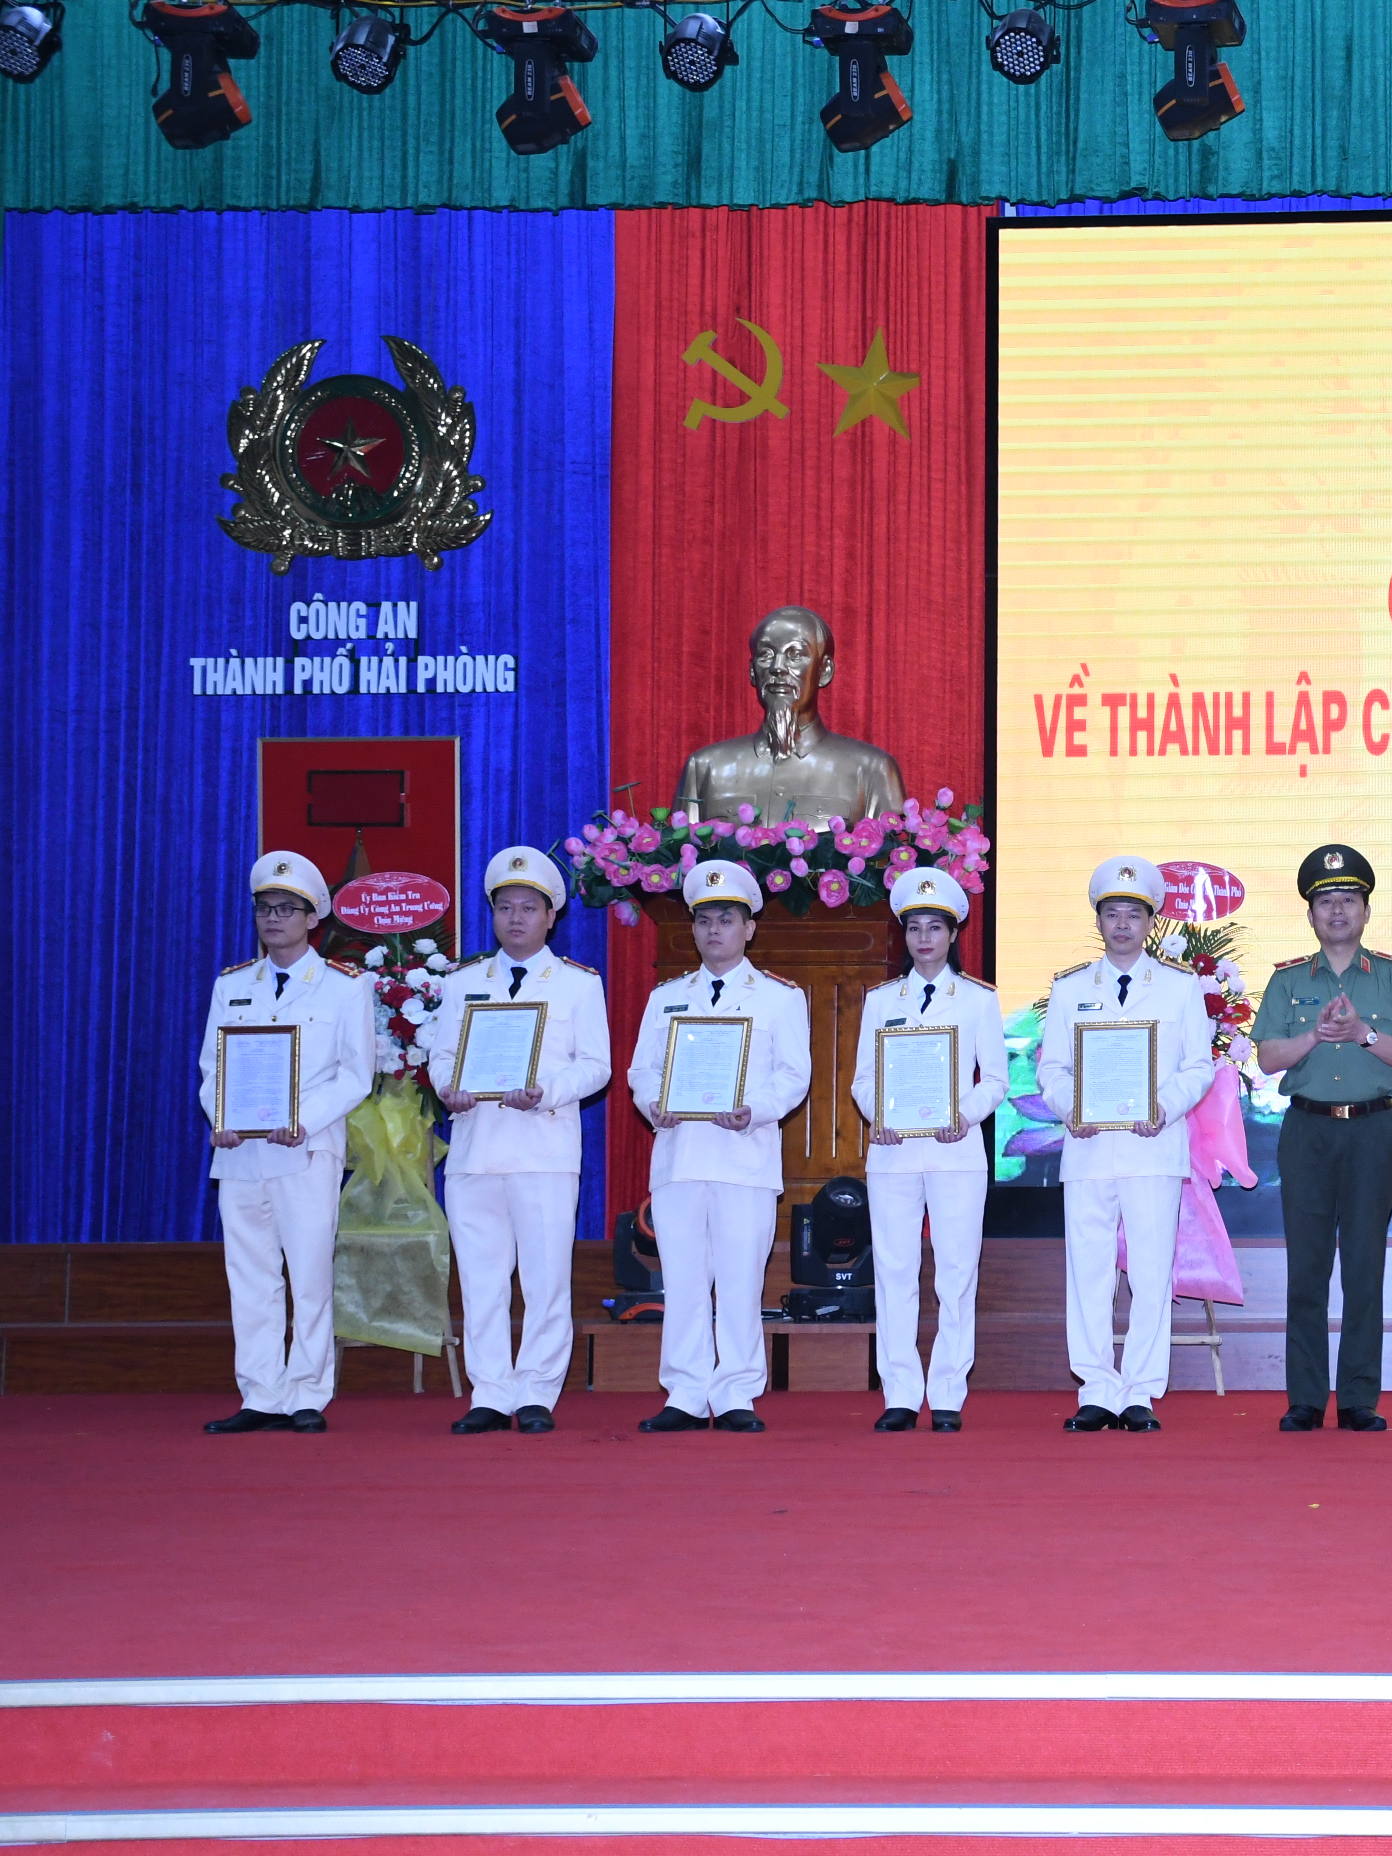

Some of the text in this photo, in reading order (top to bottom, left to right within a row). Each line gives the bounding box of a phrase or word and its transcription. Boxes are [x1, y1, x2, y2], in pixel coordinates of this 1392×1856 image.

[289, 592, 418, 640] CÔNG AN
[189, 642, 516, 696] THÀNH PHỐ HẢI PHÒNG
[1033, 662, 1091, 758] VỀ
[1101, 673, 1251, 757] THÀNH
[1265, 671, 1348, 778] LẬP
[836, 1272, 852, 1281] SVT
